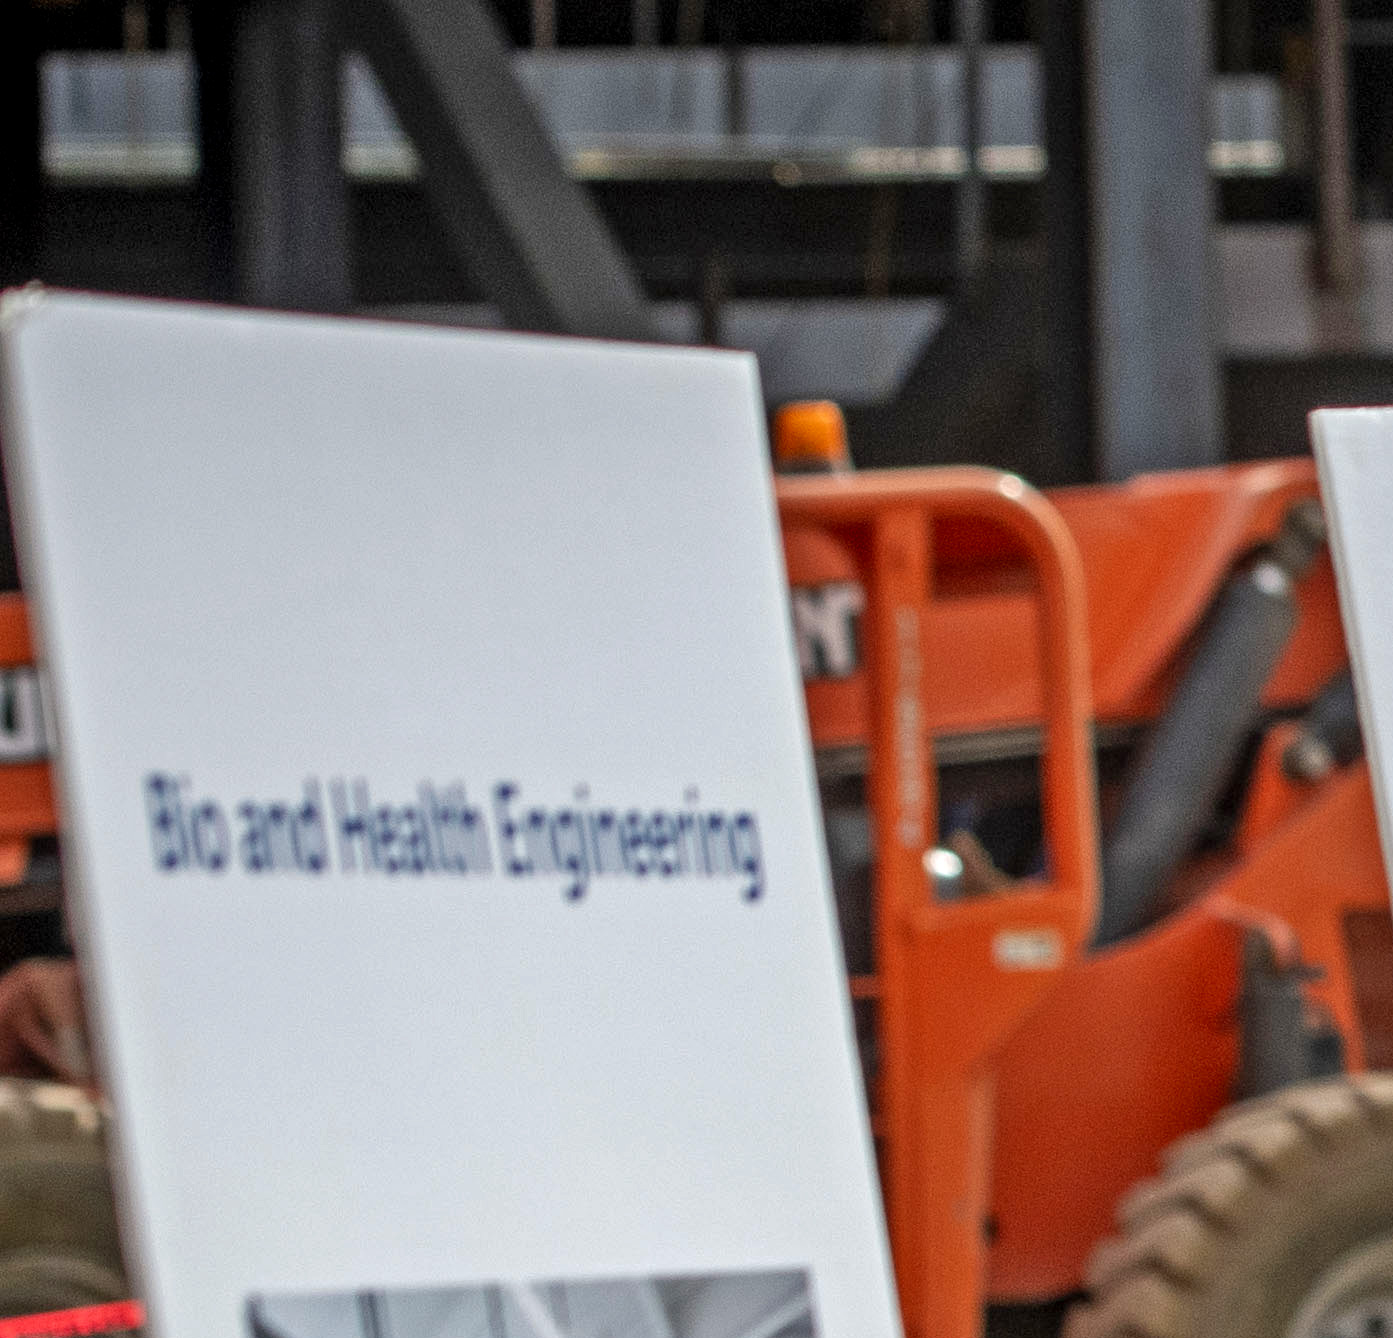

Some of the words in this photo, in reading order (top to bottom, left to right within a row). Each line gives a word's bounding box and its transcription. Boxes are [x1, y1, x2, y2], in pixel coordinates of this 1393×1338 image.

[144, 771, 232, 875] Bio
[235, 776, 327, 875] and
[328, 776, 495, 876] Health
[492, 779, 767, 905] Engineering
